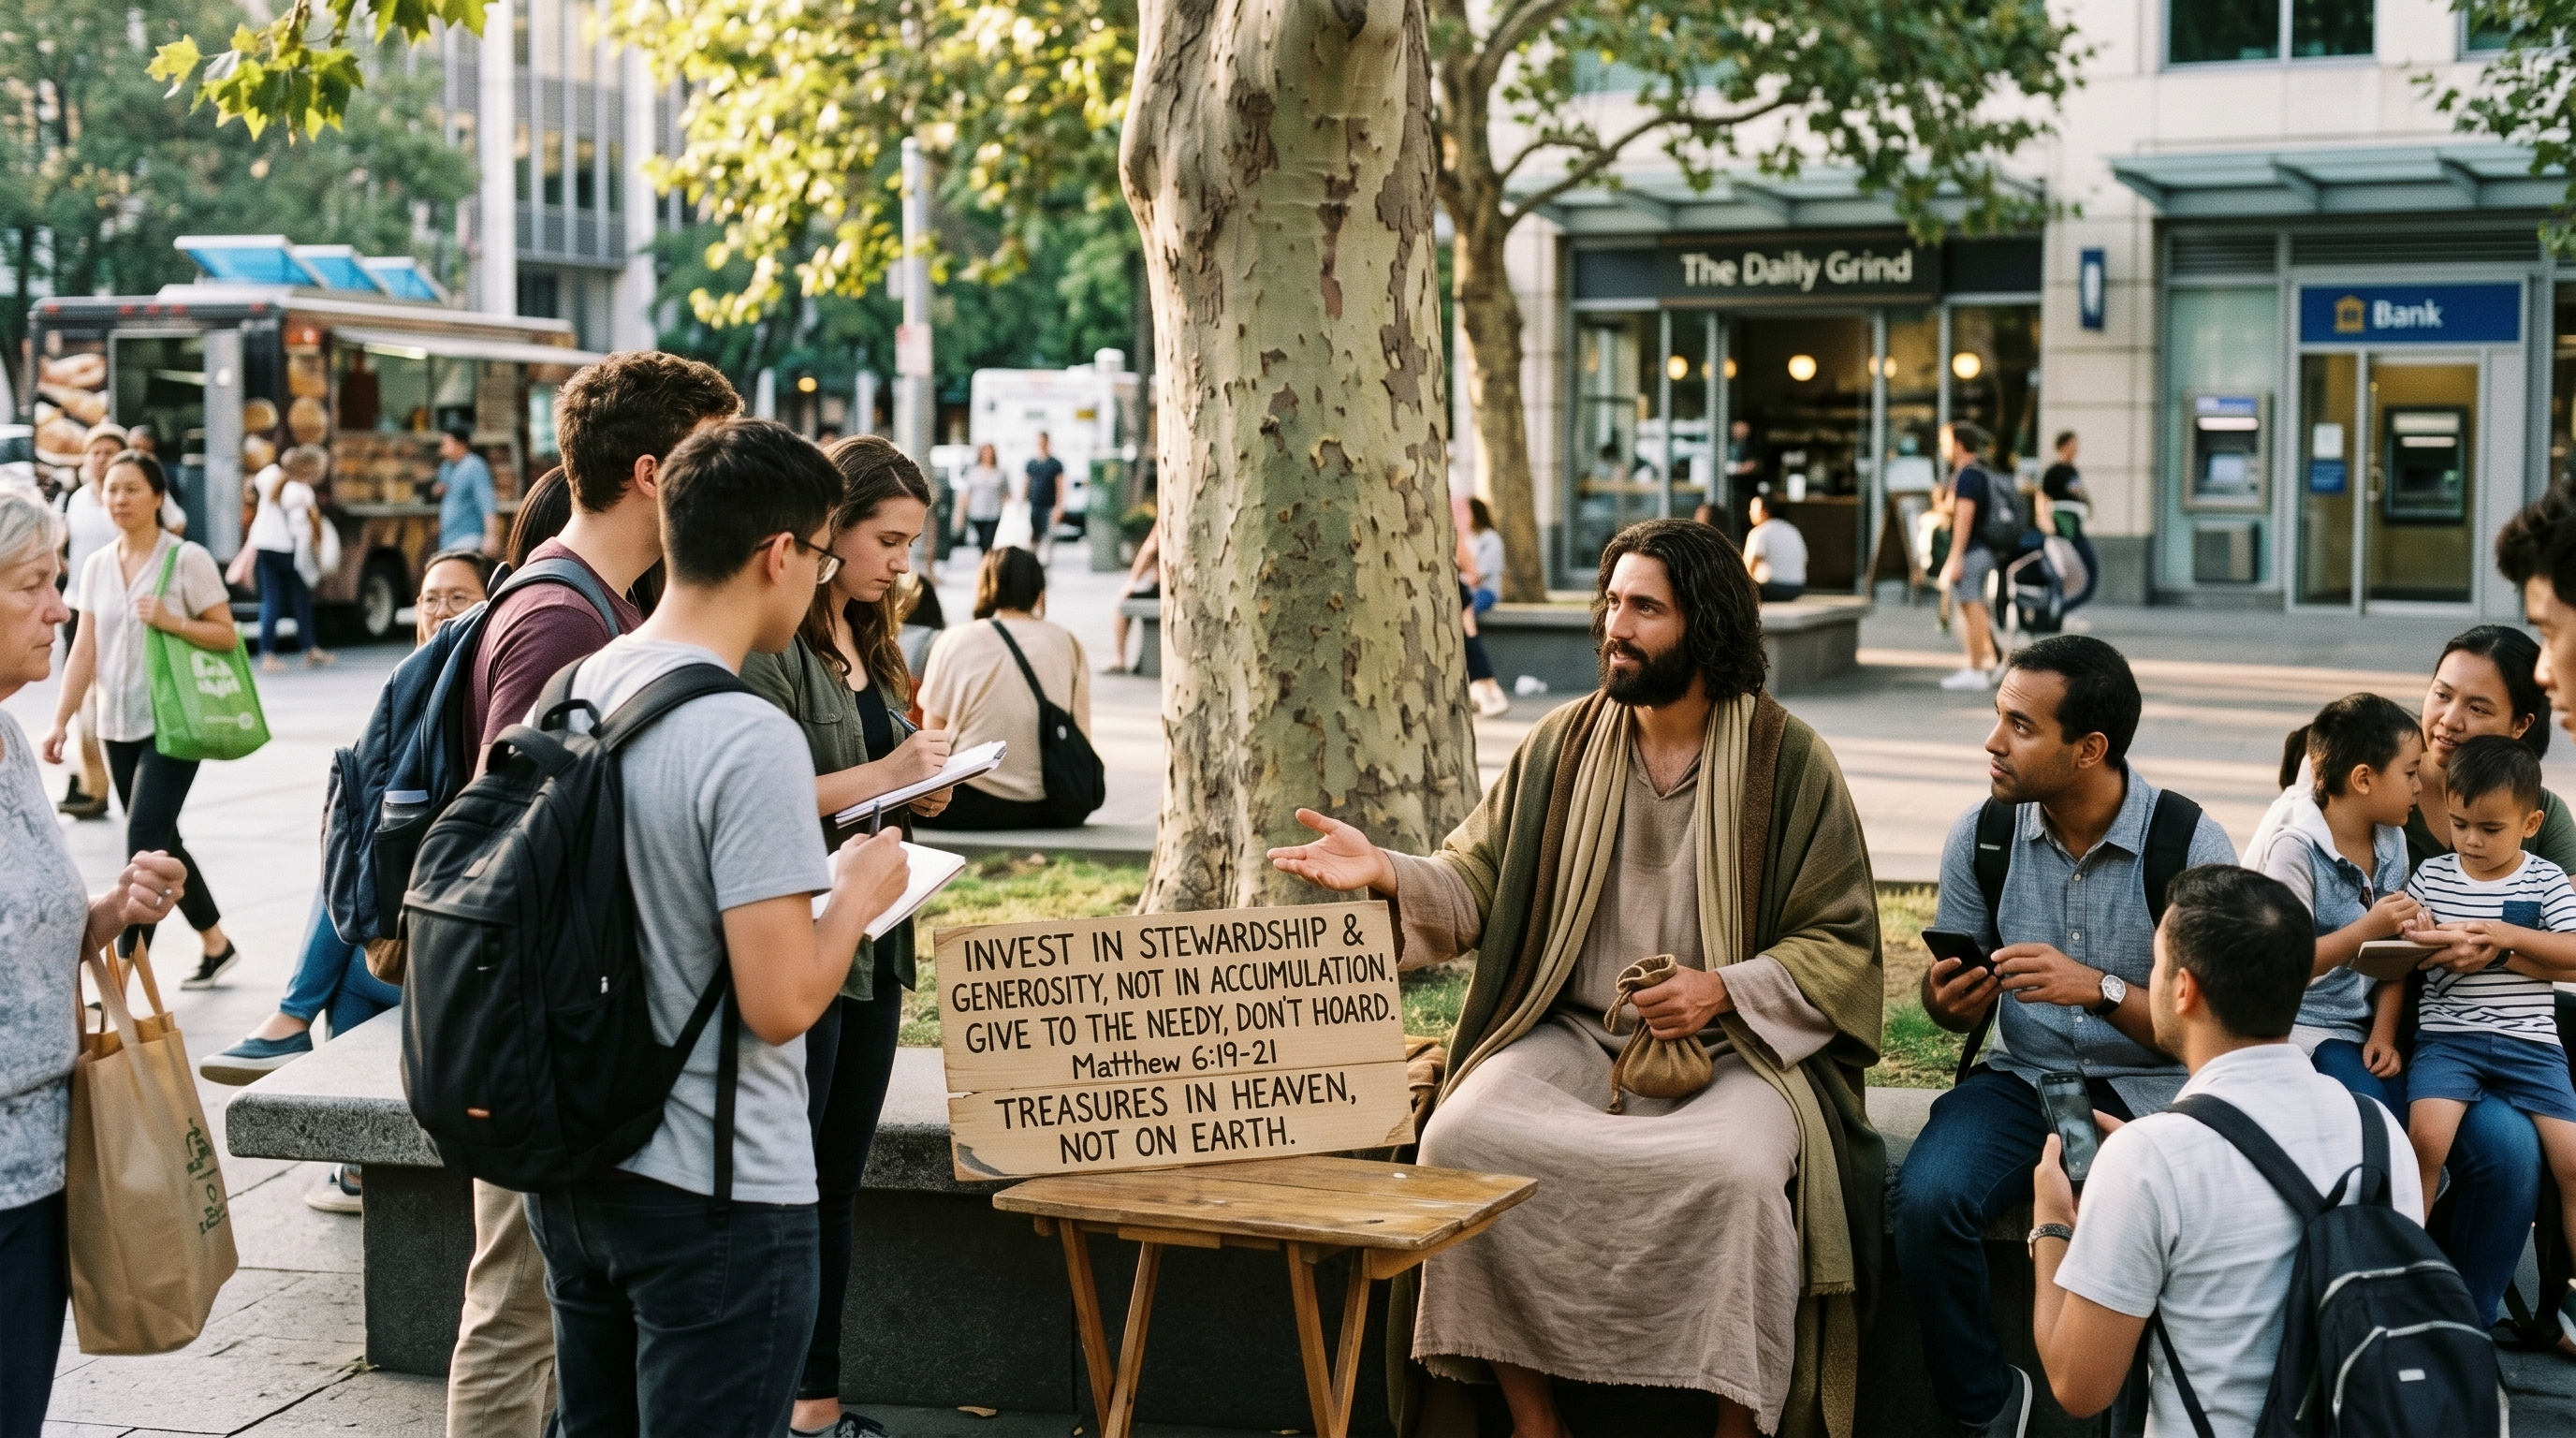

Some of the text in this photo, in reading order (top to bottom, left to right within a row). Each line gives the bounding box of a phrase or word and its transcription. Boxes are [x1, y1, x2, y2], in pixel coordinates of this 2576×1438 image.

[1682, 251, 1913, 290] The Daily Grind
[2373, 301, 2441, 328] Bank
[964, 913, 1364, 972] INVEST IN STEWARDSHIP &
[952, 952, 1395, 1013] GENEROSITY, NOT IN ACCUMULATION.
[965, 992, 1397, 1054] GIVE TO THE NEEDY, DON'T HOARD.
[1072, 1038, 1278, 1079] Matthew 6:19-21
[994, 1071, 1357, 1129] TREASURES IN HEAVEN,
[1060, 1116, 1296, 1164] NOT ON EARTH.
